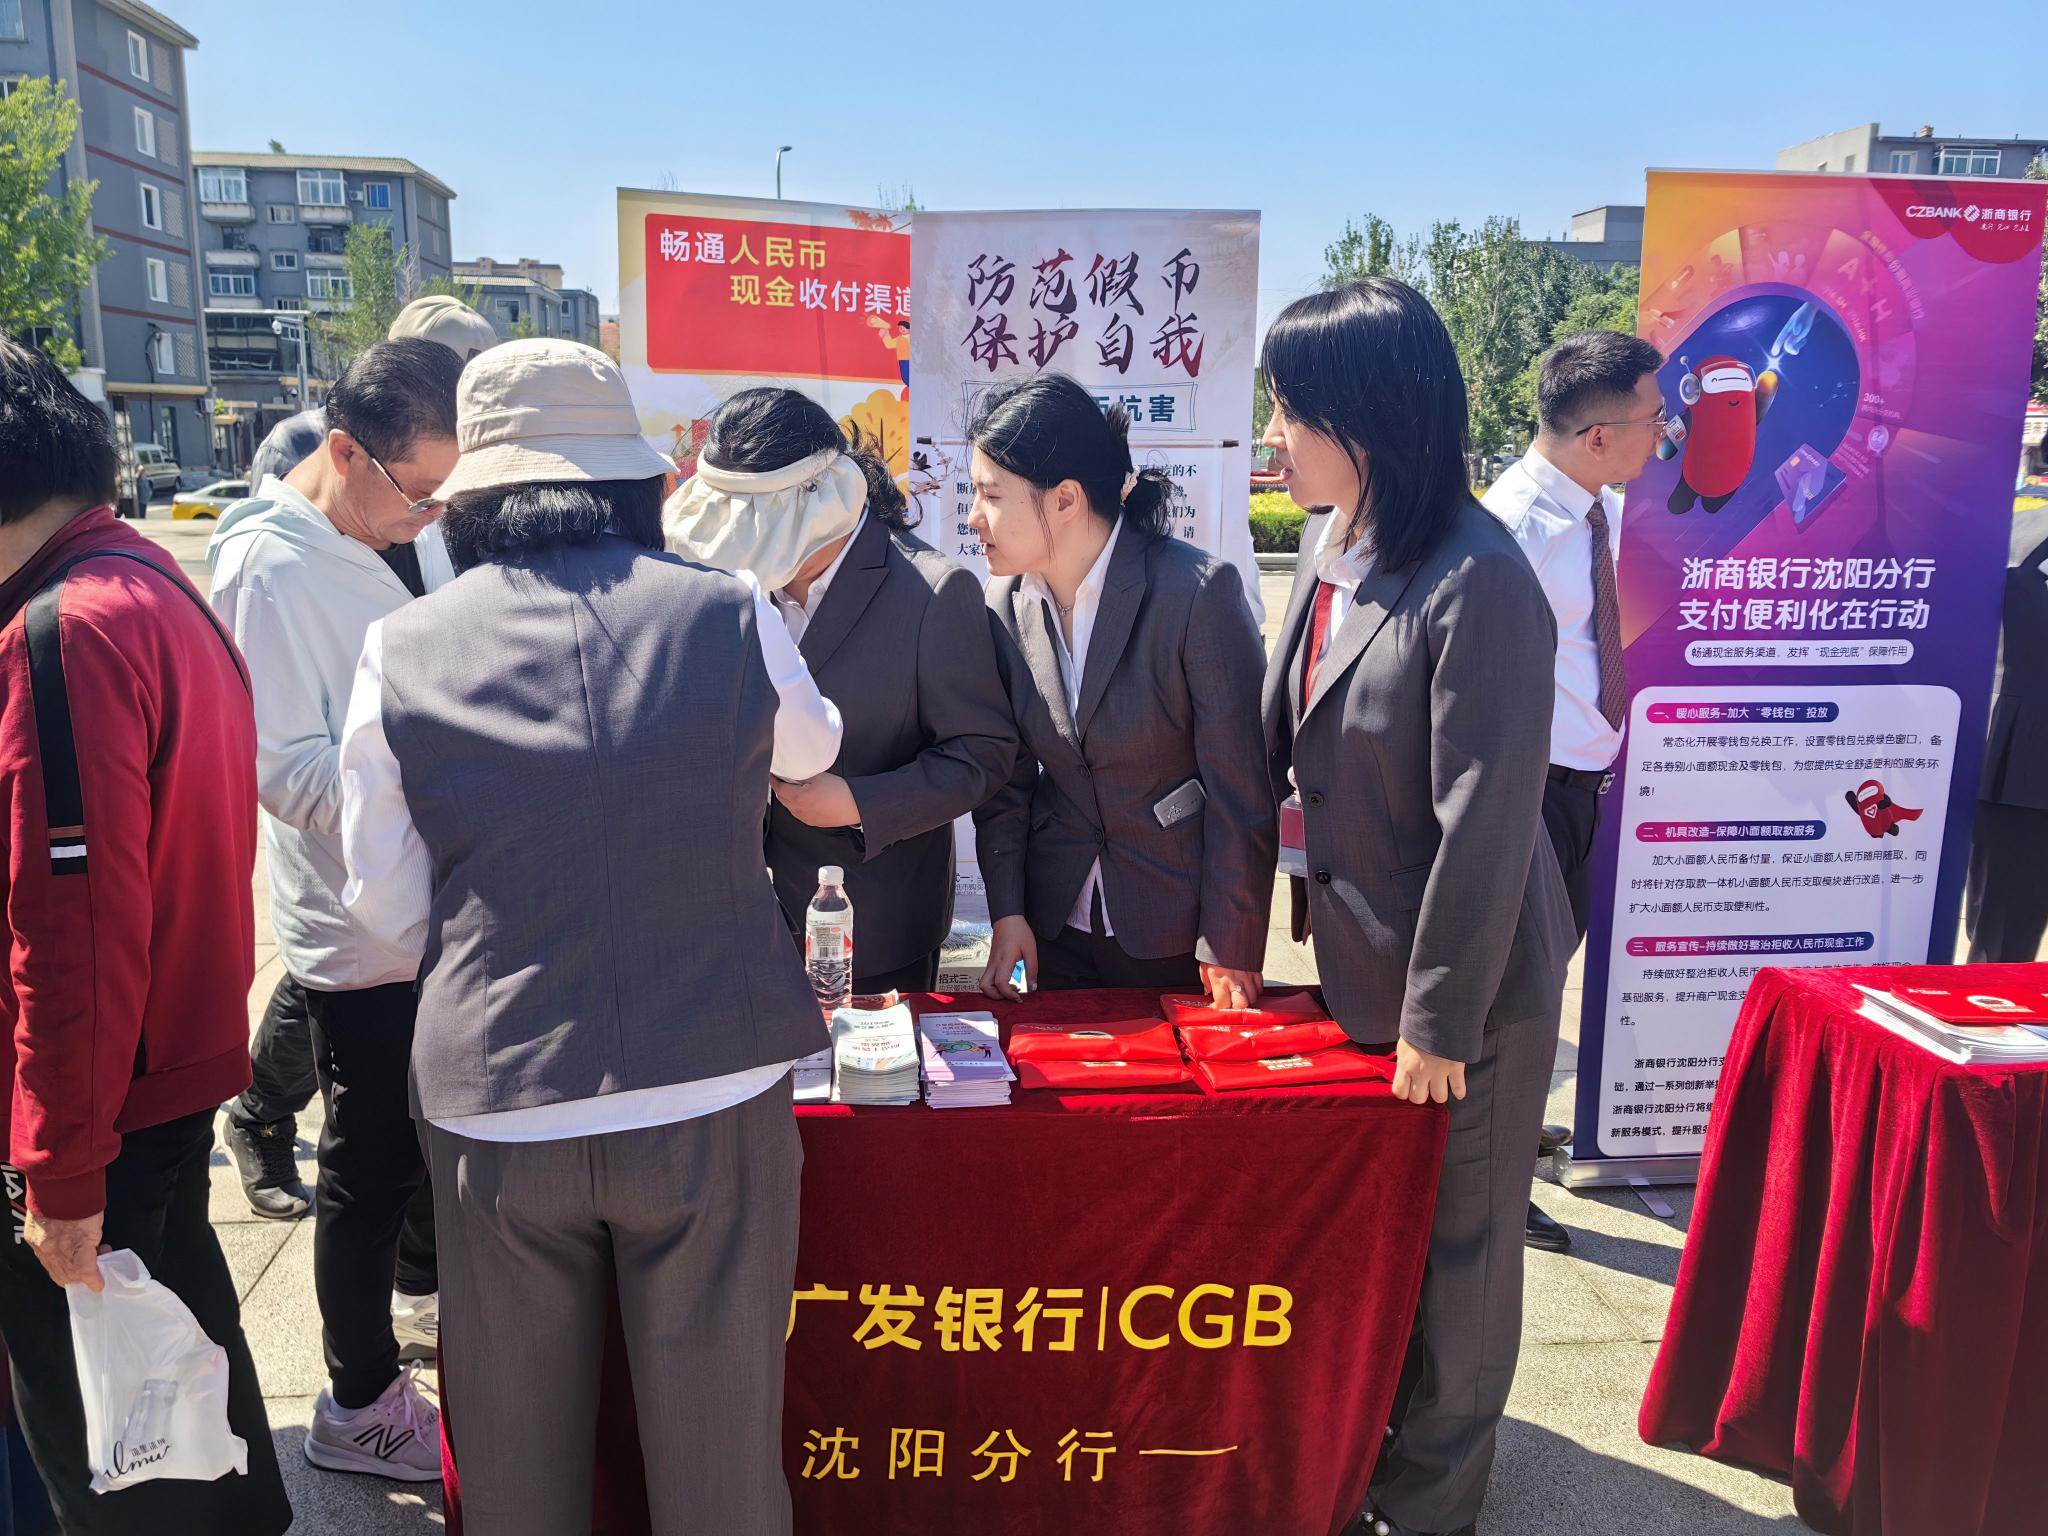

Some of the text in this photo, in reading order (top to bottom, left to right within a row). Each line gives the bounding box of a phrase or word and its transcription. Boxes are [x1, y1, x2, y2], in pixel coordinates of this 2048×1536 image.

[1905, 205, 1962, 219] CZBANK
[1981, 208, 2032, 222] 浙商银行
[660, 228, 827, 270] 畅通人民币
[967, 248, 1200, 315] 防范假币
[960, 312, 1205, 378] 保护自我
[957, 502, 973, 515] 但
[1681, 557, 1936, 590] 浙商银行沈阳分行
[1676, 598, 1930, 631] 支付便利化在行动
[1628, 901, 1770, 914] 扩大小面额人民币支取便利性。
[1118, 1284, 1294, 1350] CGB
[801, 1427, 1117, 1483] 沈阳分行
